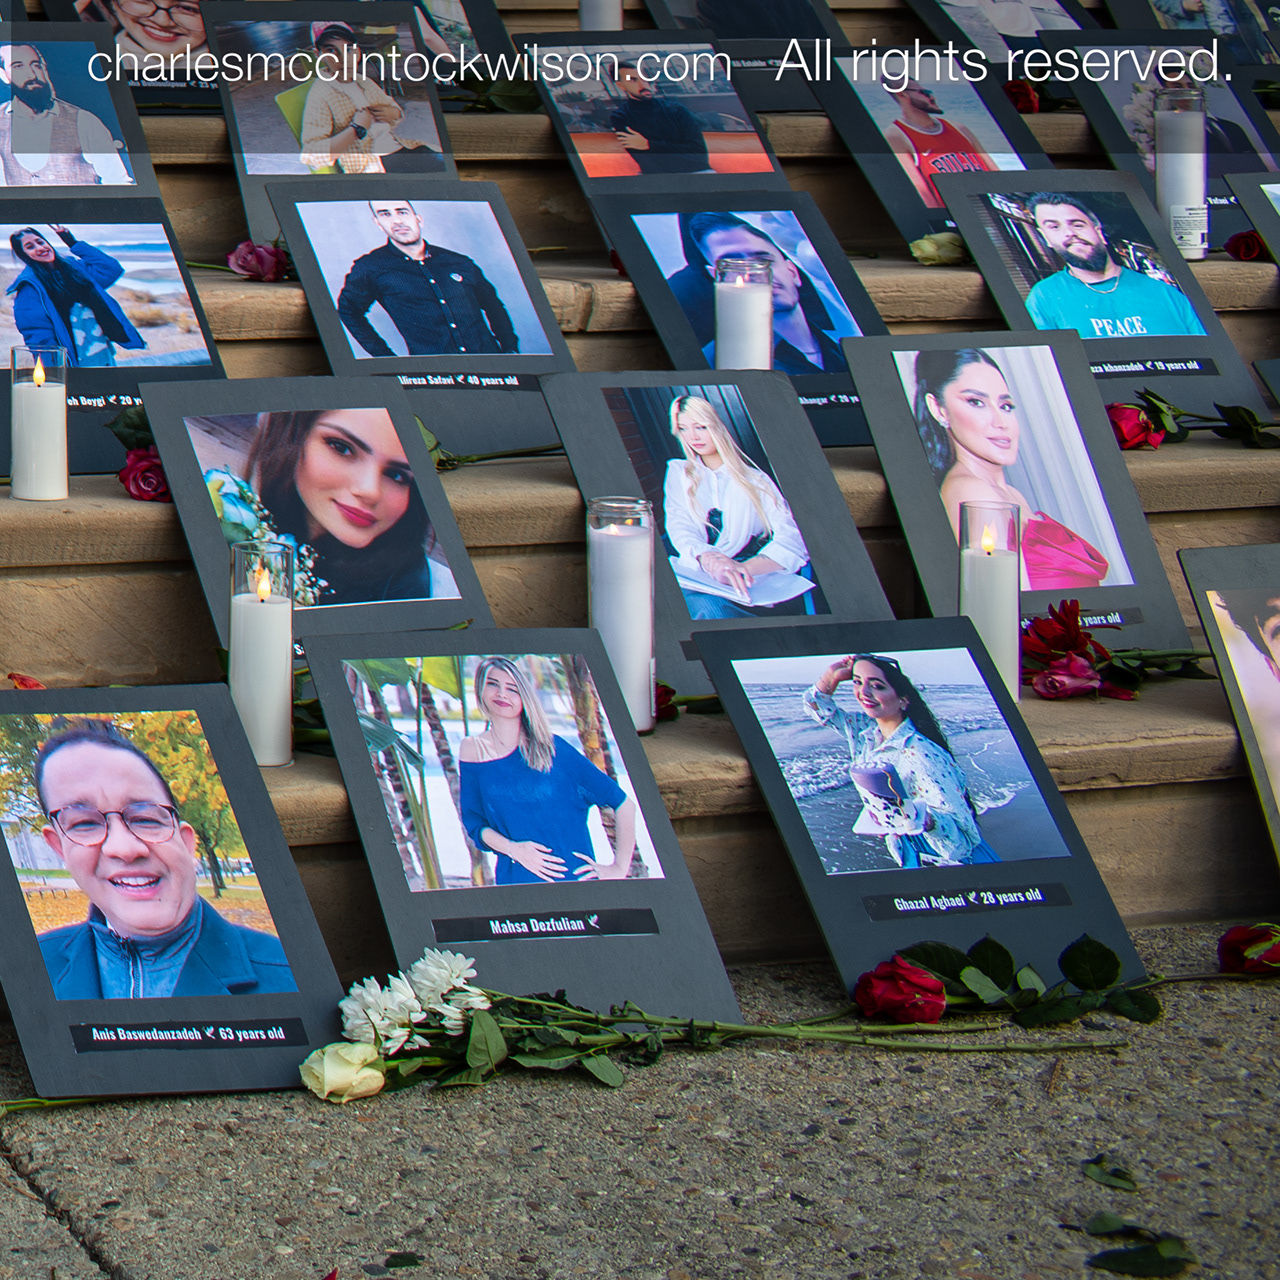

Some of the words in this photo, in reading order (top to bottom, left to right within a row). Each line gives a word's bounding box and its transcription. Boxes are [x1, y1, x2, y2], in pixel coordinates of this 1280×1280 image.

[1090, 316, 1147, 336] PEACE
[1155, 361, 1164, 370] 19
[1165, 362, 1186, 371] years
[1187, 361, 1199, 369] old
[427, 375, 454, 385] Safavi
[467, 375, 479, 385] 40
[480, 376, 503, 386] years
[505, 376, 519, 385] old
[1082, 614, 1106, 626] years
[1107, 612, 1121, 624] old
[894, 896, 930, 911] Ghazal
[930, 894, 966, 910] Aghaei
[980, 892, 996, 905] 28
[996, 893, 1025, 906] years
[1025, 888, 1043, 901] old
[489, 919, 529, 934] Mahsa
[529, 917, 585, 932] Dezfulian
[92, 1027, 117, 1041] Anis
[219, 1027, 234, 1040] 63
[235, 1028, 266, 1042] years
[268, 1026, 285, 1040] old
